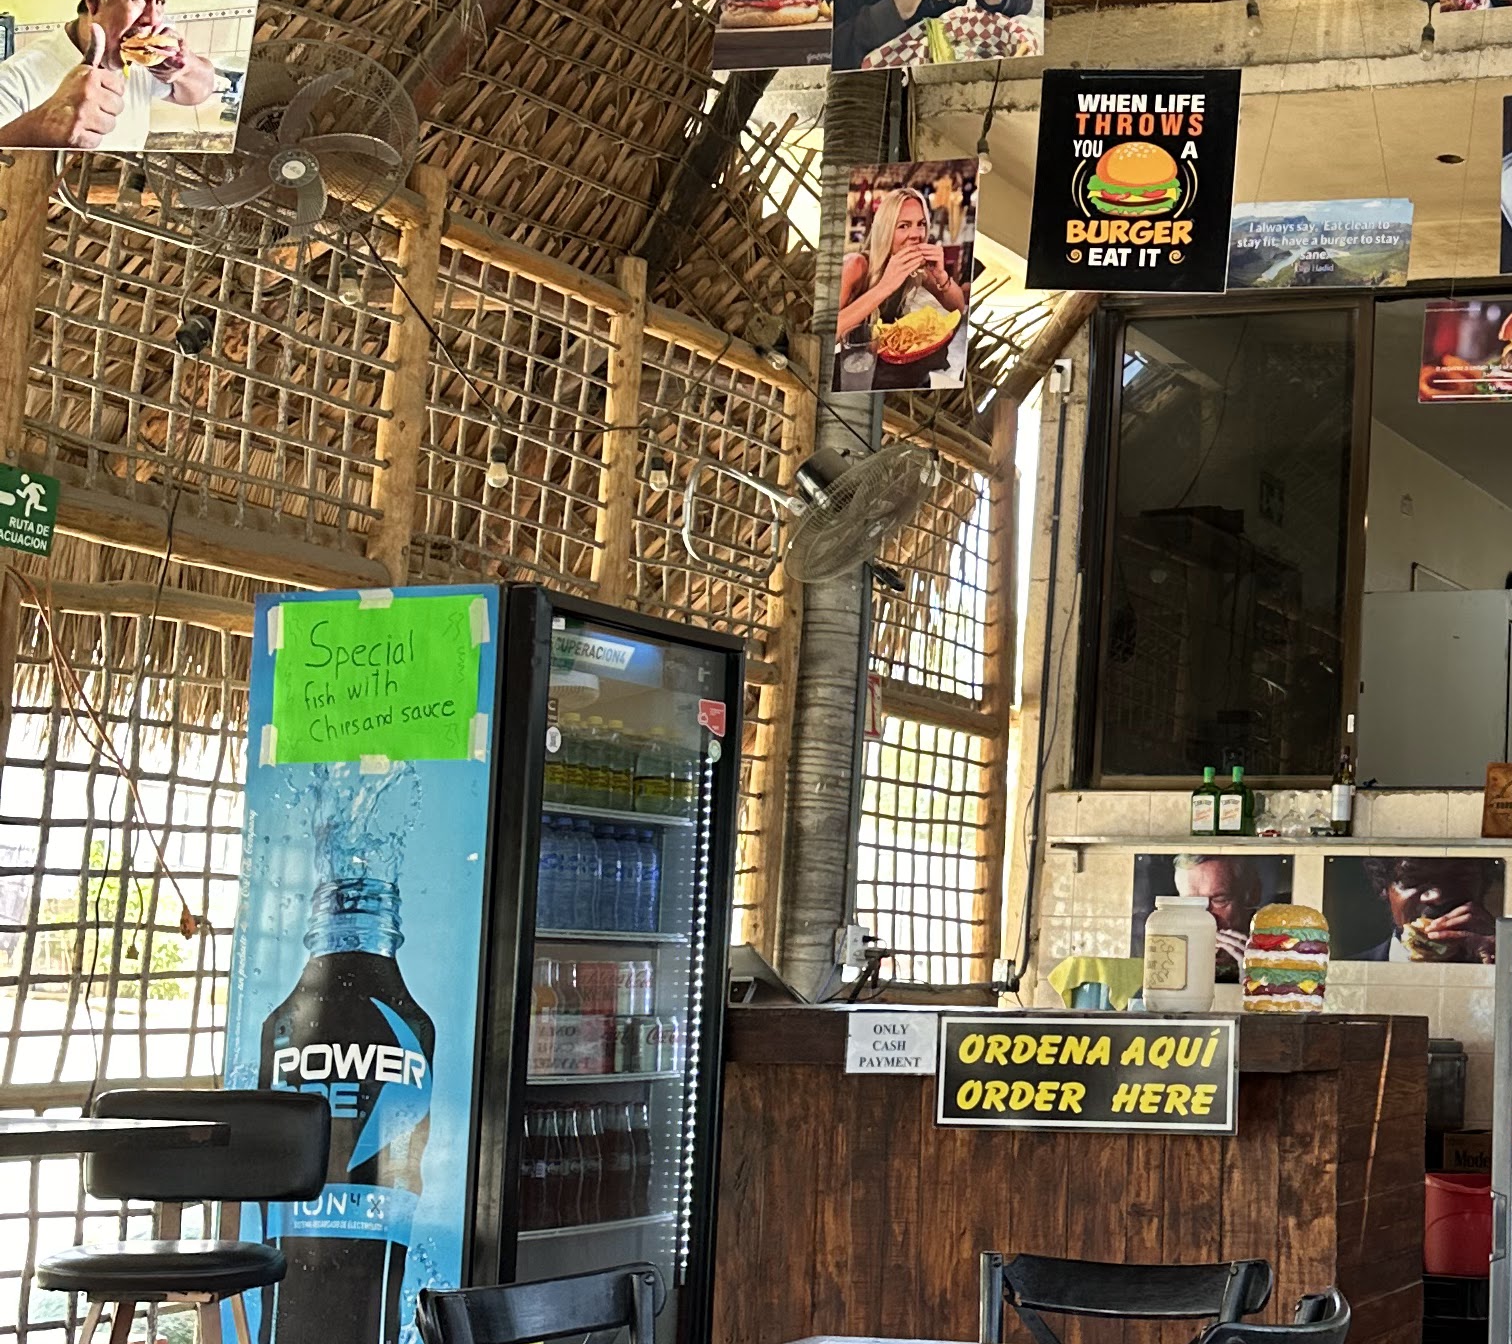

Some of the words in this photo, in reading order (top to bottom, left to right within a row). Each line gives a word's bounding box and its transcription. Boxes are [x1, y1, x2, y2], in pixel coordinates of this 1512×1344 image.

[1077, 94, 1148, 114] WHEN
[1154, 94, 1206, 113] LIFE
[1076, 112, 1204, 136] THROWS
[1073, 139, 1103, 158] YOU
[1180, 141, 1198, 159] A
[1066, 219, 1193, 245] BURGER
[1255, 222, 1294, 234] always
[1344, 220, 1376, 230] clean
[1378, 220, 1390, 230] to
[1237, 239, 1262, 249] stay
[1282, 236, 1308, 246] have
[1320, 234, 1358, 247] burger
[1360, 235, 1372, 244] to
[1375, 234, 1400, 245] stay
[1088, 248, 1132, 267] EAT
[1138, 248, 1162, 268] IT
[8, 516, 34, 533] RUTA
[36, 523, 50, 536] DE
[304, 620, 414, 679] Special
[304, 680, 336, 710] fish
[347, 669, 398, 701] with
[402, 698, 456, 722] sauce
[873, 1023, 909, 1036] ONLY
[872, 1040, 906, 1052] CASH
[958, 1033, 1111, 1066] ORDENA
[1120, 1027, 1222, 1070] AQUÍ
[272, 1043, 426, 1090] POWER
[858, 1056, 922, 1068] PAYMENT
[956, 1080, 1087, 1114] ORDER
[1110, 1082, 1218, 1117] HERE
[1454, 1149, 1492, 1169] Mode
